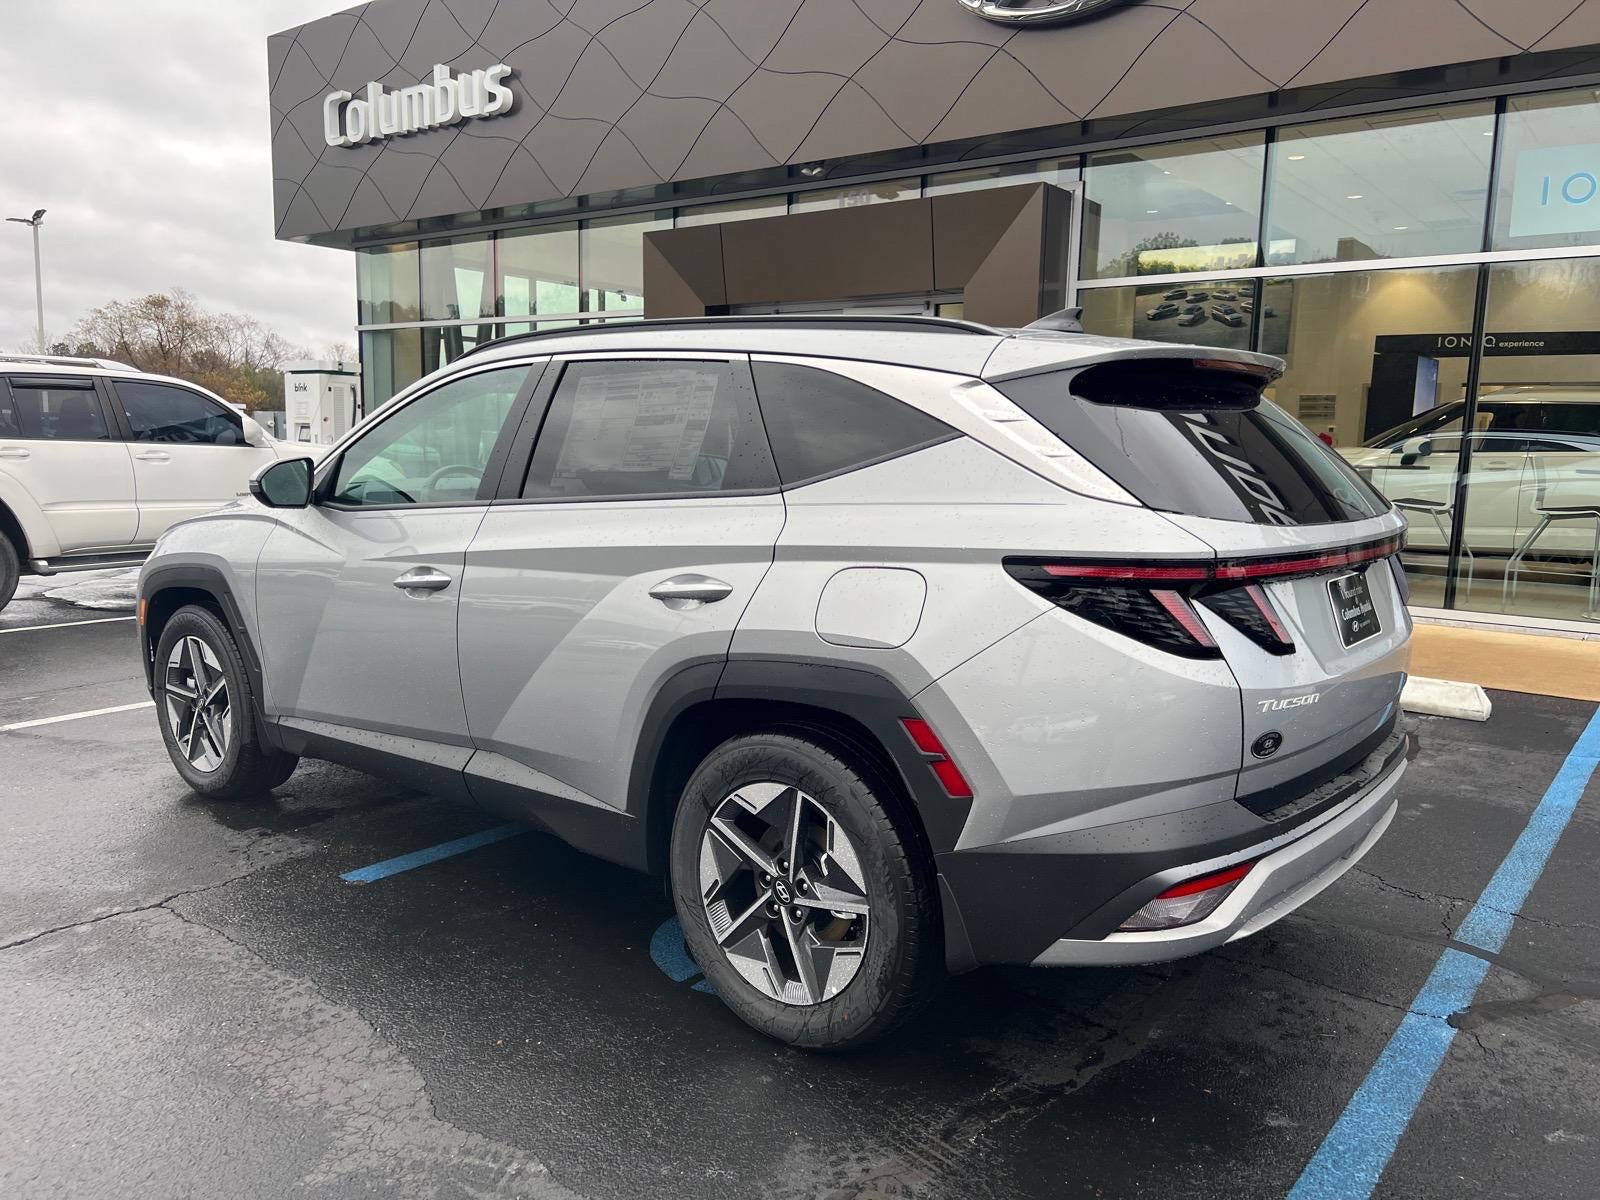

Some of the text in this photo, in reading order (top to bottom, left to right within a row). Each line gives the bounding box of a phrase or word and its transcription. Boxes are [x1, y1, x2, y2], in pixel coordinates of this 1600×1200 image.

[323, 63, 514, 147] Columbus
[1437, 335, 1545, 349] IONQ experience
